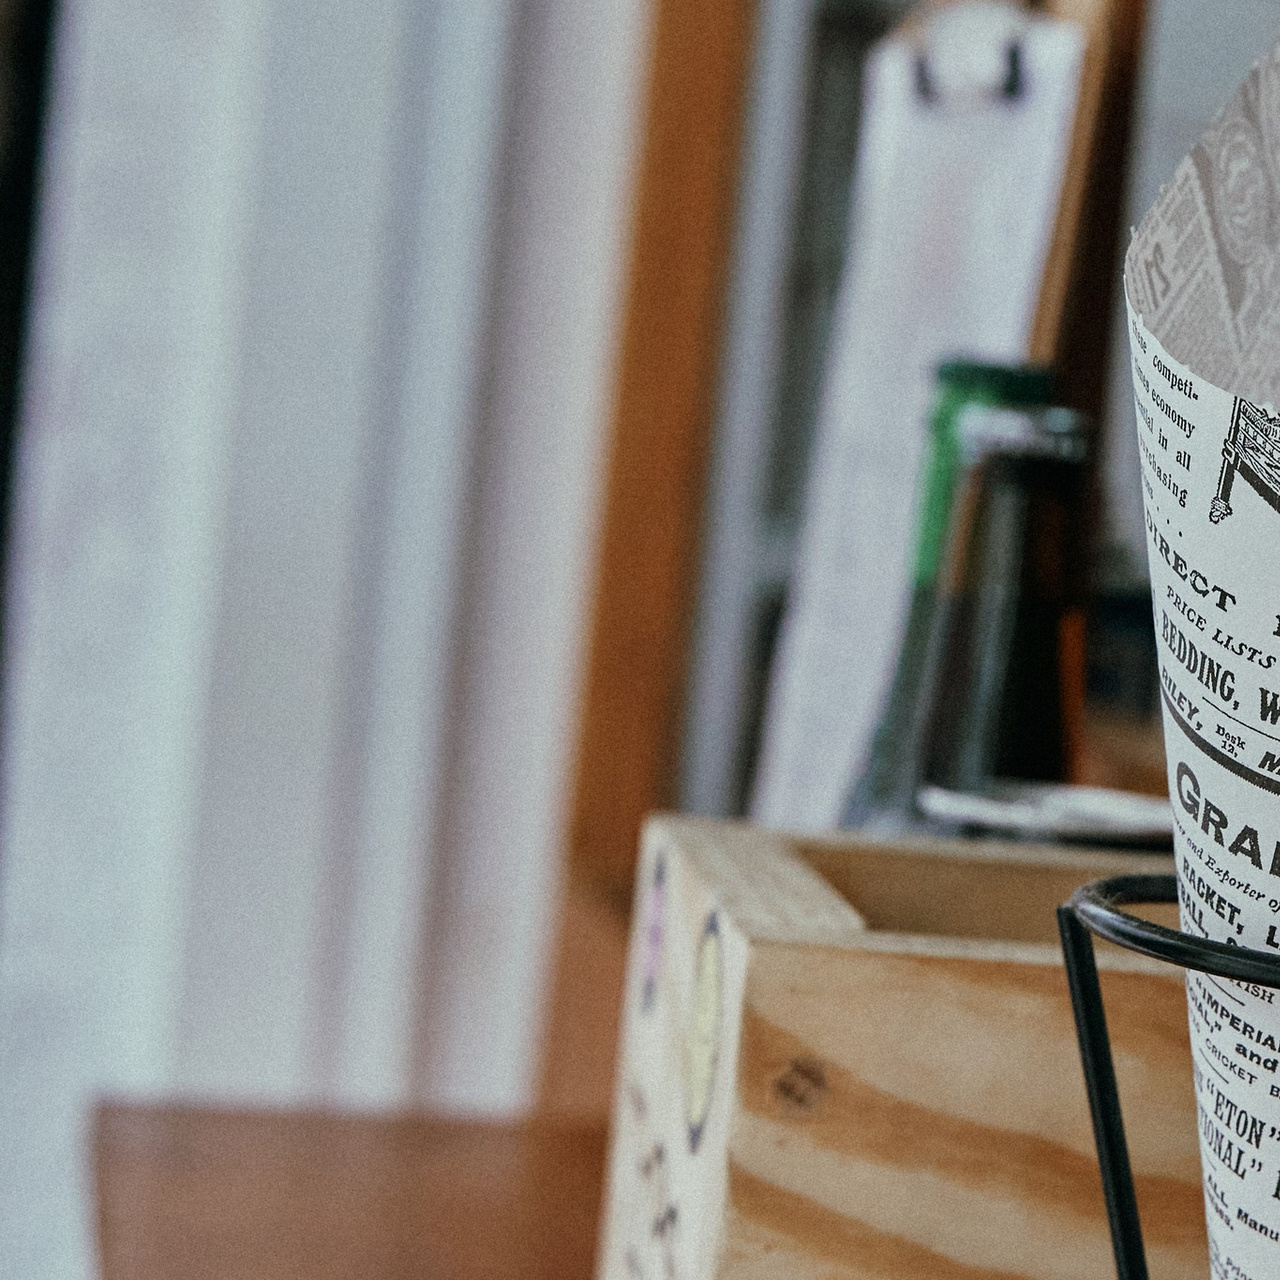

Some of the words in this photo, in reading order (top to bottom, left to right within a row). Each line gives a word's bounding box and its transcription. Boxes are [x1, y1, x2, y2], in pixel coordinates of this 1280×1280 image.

[1151, 388, 1195, 439] economy
[1158, 427, 1168, 451] in
[1176, 451, 1191, 472] all
[1147, 507, 1237, 612] DIRECT
[1167, 586, 1207, 631] PRICE
[1212, 628, 1276, 669] LISTS
[1162, 609, 1239, 710] BEDDING,
[1215, 724, 1246, 750] Desk
[1183, 856, 1245, 935] RACKET,
[1187, 838, 1203, 859] and
[1205, 855, 1265, 900] Exporter
[1180, 883, 1208, 938] BALL,
[1205, 1038, 1257, 1084] CRICKET
[1234, 1042, 1279, 1073] and
